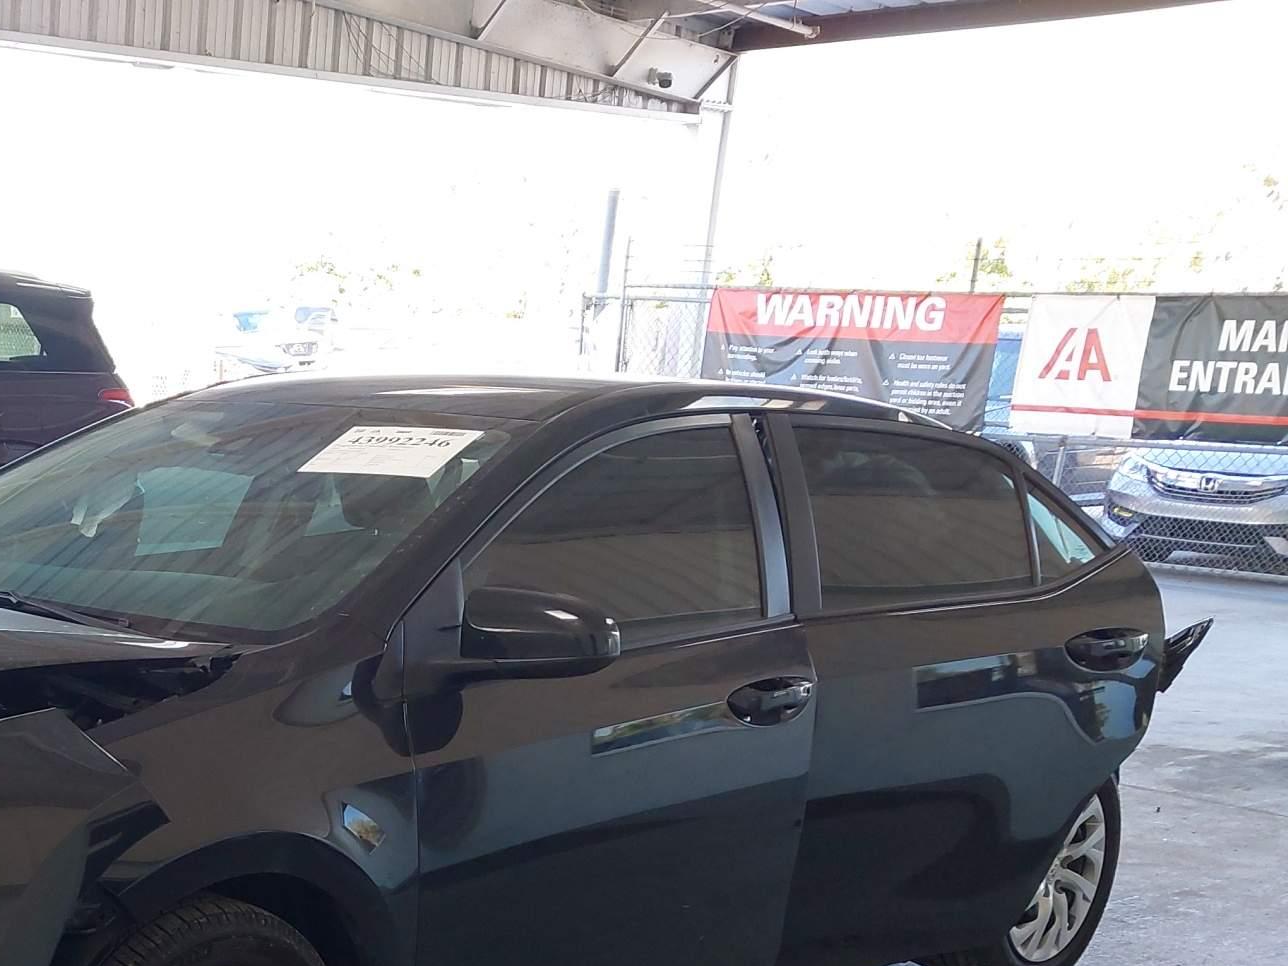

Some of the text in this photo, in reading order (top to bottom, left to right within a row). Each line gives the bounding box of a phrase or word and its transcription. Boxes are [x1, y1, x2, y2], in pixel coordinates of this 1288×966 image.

[756, 293, 947, 332] WARNING
[1168, 360, 1288, 395] ENTRA
[348, 436, 451, 447] 43992246
